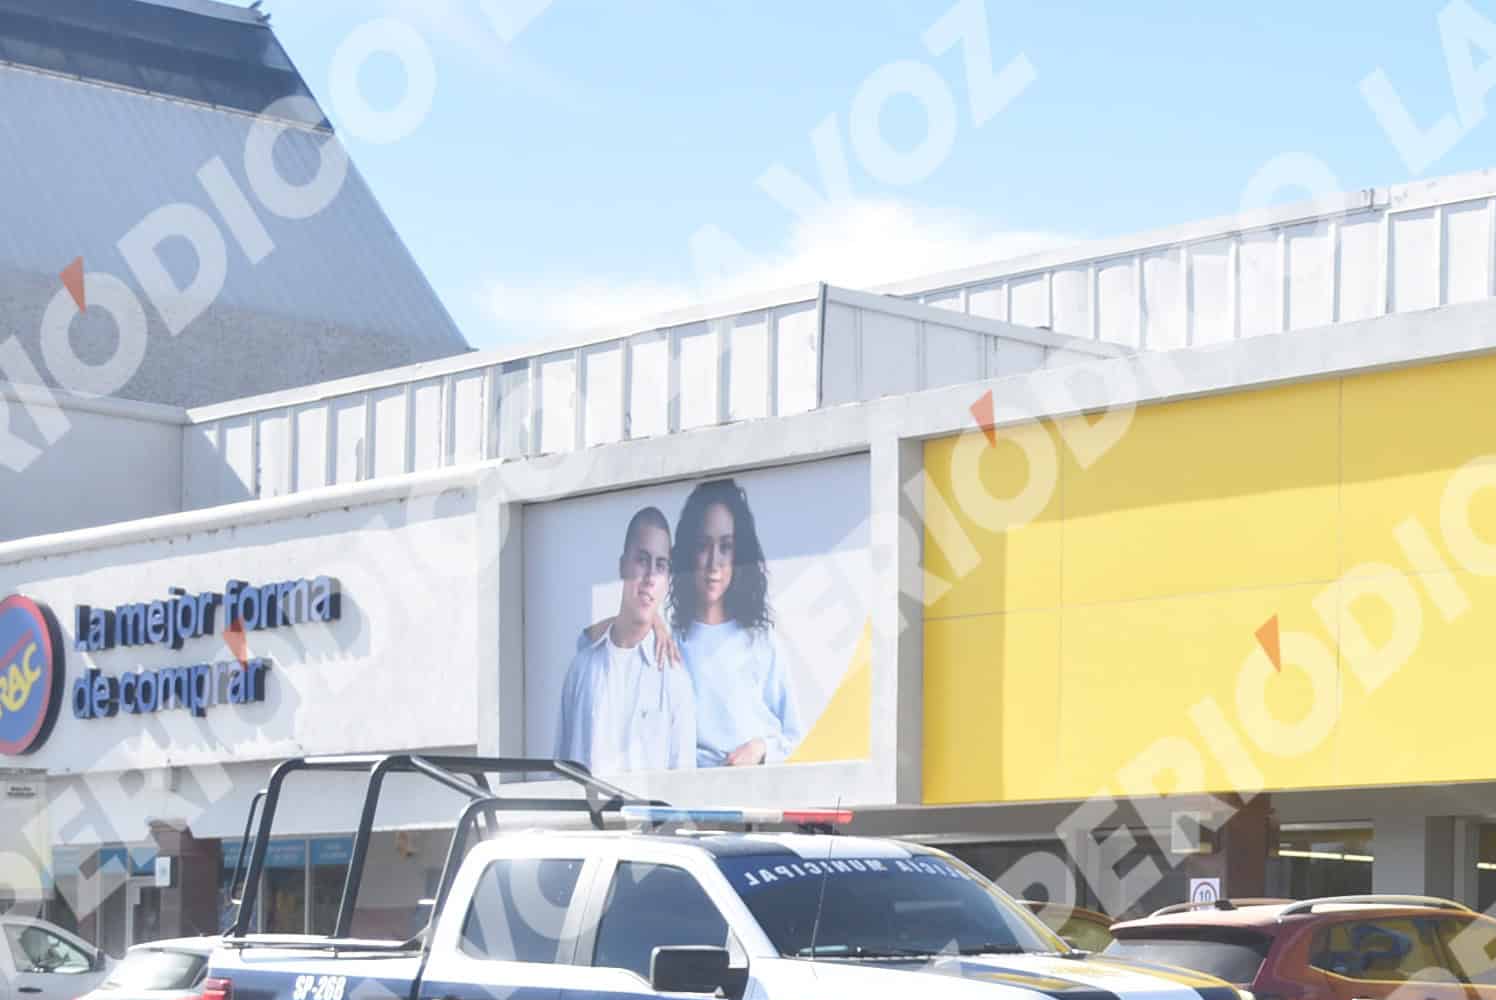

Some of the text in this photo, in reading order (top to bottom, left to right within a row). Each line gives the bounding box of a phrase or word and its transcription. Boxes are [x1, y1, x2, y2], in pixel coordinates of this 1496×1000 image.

[74, 576, 339, 652] La mejor forma
[73, 657, 269, 721] de comprar
